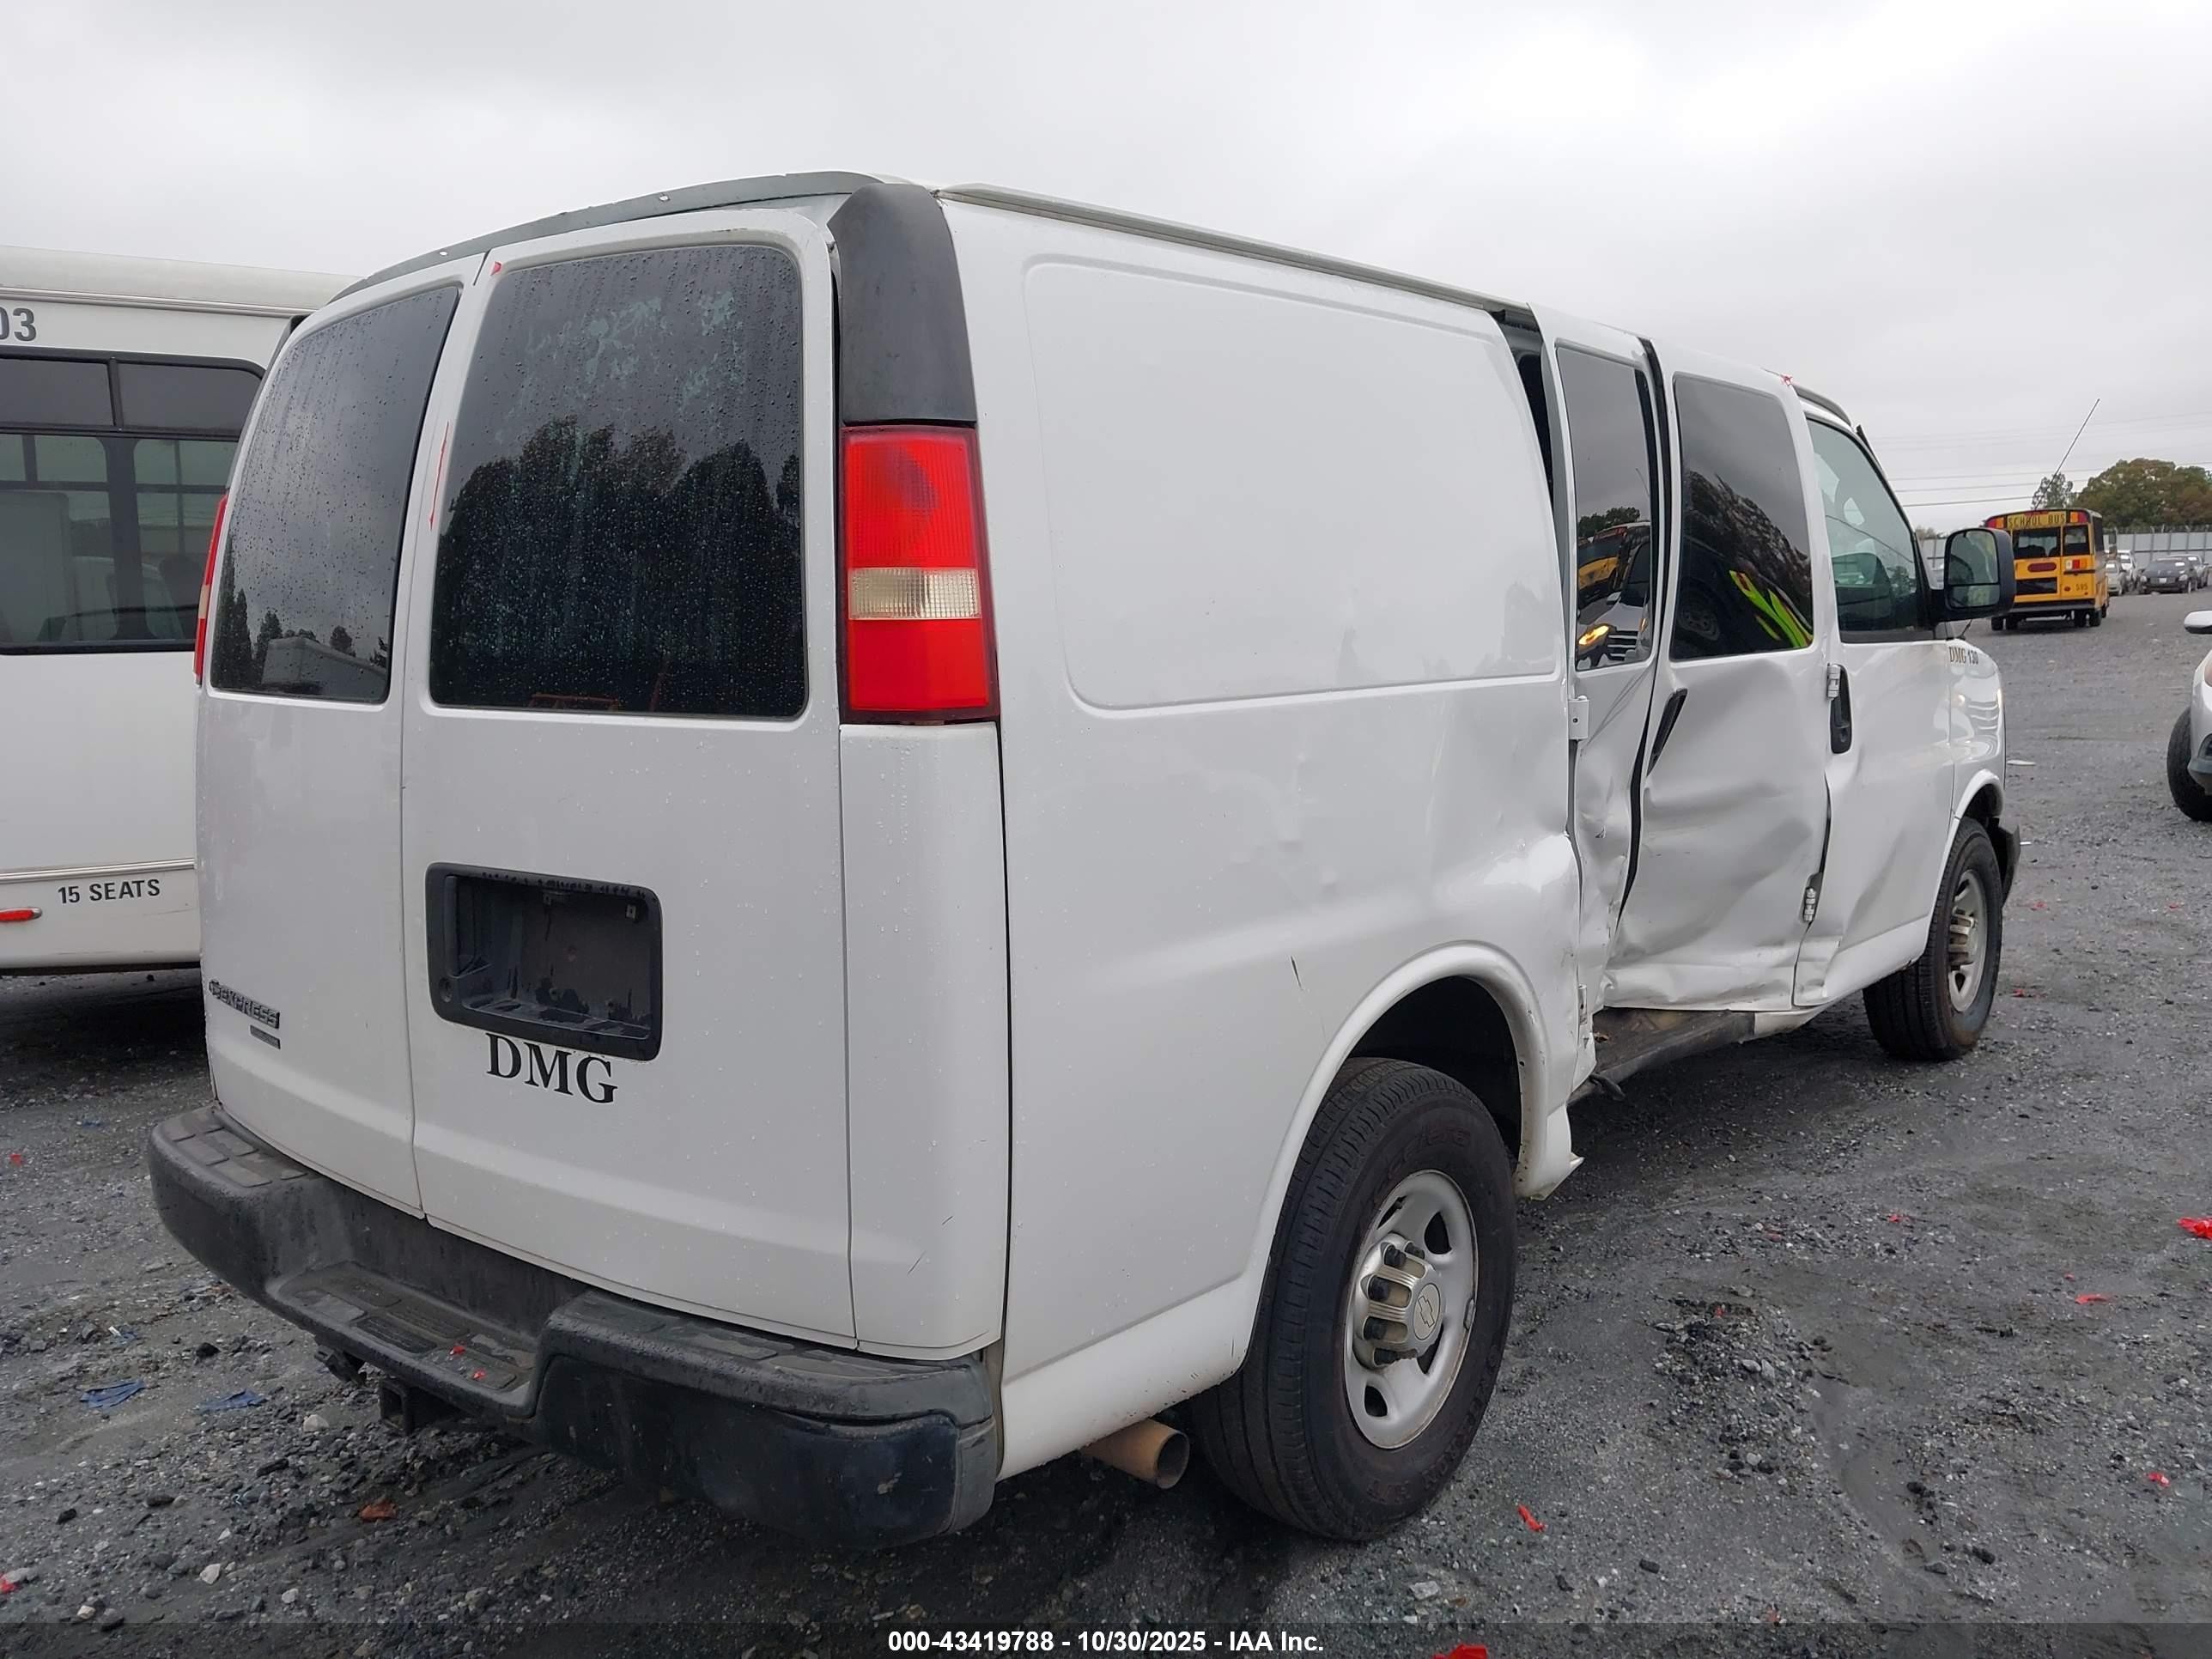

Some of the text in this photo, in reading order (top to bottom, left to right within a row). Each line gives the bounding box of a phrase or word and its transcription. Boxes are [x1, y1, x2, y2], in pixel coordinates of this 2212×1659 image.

[2008, 514, 2065, 527] SCHOOL BUS
[58, 878, 161, 904] 15 SEATS
[219, 987, 278, 1025] EXPRESS
[486, 1032, 618, 1103] DMG
